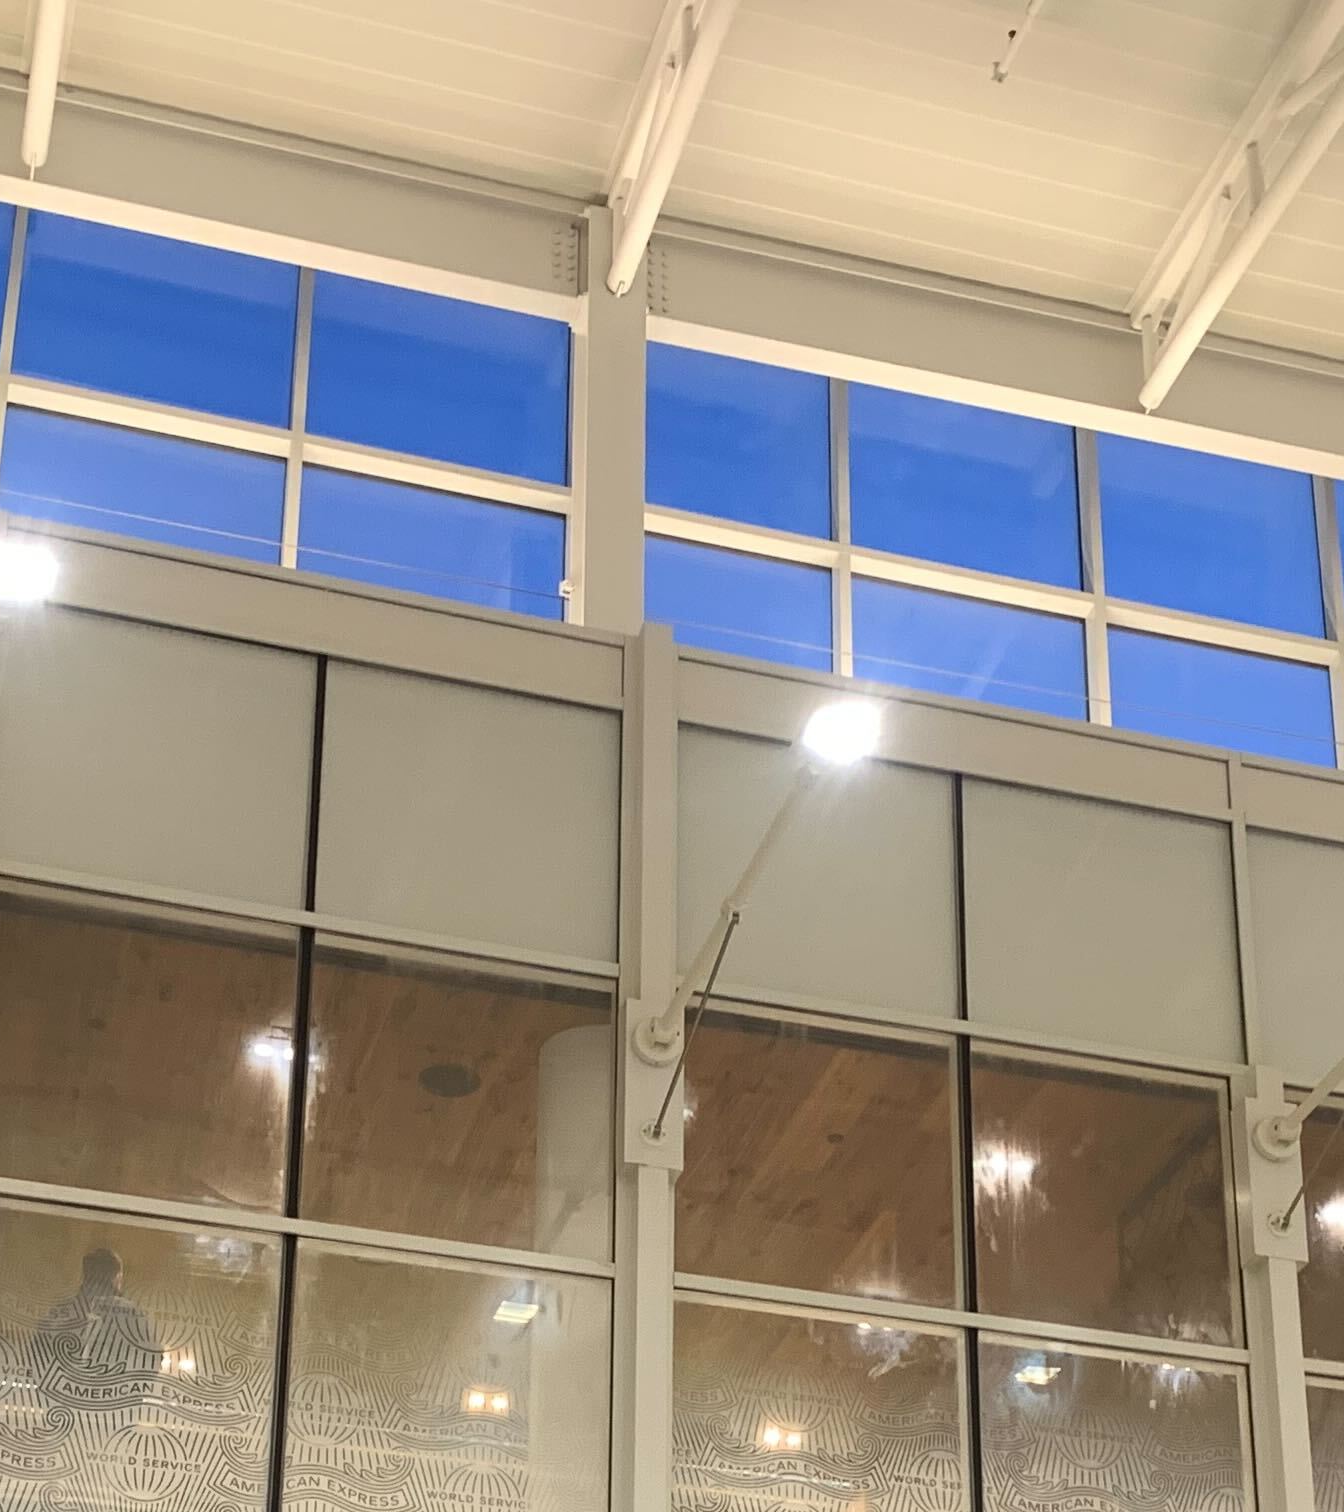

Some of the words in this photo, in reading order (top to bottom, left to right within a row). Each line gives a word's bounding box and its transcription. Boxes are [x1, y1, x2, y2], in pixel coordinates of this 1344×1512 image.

[62, 1382, 155, 1400] AMERICAN
[160, 1387, 236, 1413] EXPRESS
[319, 1403, 376, 1419] SERVICE
[867, 1411, 947, 1425] AMERICAN
[86, 1452, 138, 1466] WORLD
[143, 1458, 202, 1474] SERVICE
[893, 1474, 936, 1488] WORLD
[327, 1479, 400, 1507] EXPRESS
[426, 1490, 475, 1504] WORLD
[479, 1495, 529, 1510] SERVIC
[1018, 1498, 1094, 1512] AMERICAN
